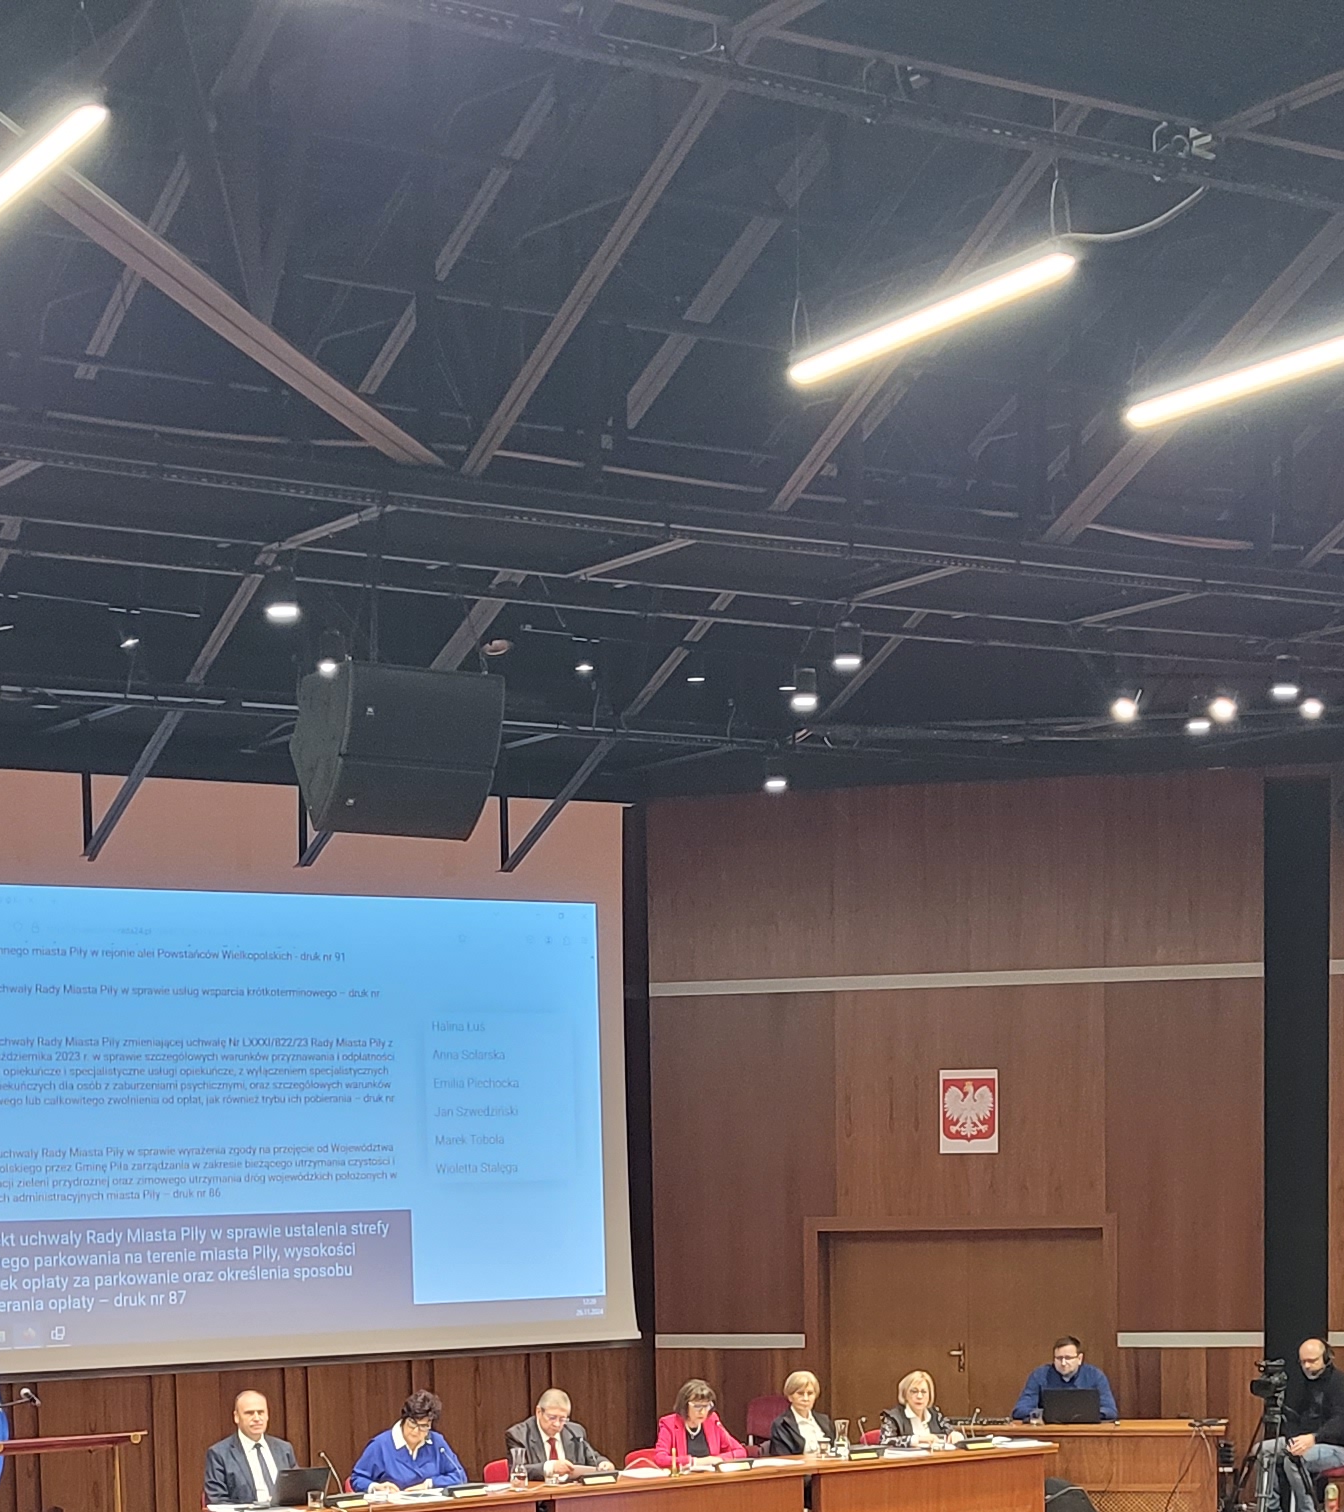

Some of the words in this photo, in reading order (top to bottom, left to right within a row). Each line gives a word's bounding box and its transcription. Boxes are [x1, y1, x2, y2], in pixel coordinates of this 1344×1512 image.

[432, 1020, 464, 1032] Halina
[432, 1049, 459, 1060] Anna
[433, 1078, 464, 1089] Emilia
[467, 1077, 519, 1088] Piechocka
[434, 1106, 453, 1117] Jan
[435, 1134, 466, 1145] Marek
[435, 1163, 477, 1174] Wioletta
[86, 1229, 122, 1248] Rady
[126, 1227, 176, 1243] Miasta
[210, 1229, 222, 1241] w
[226, 1224, 281, 1243] sprawie
[284, 1222, 346, 1239] ustalenia
[350, 1221, 388, 1240] strefy
[33, 1249, 120, 1270] parkowania
[124, 1252, 142, 1264] na
[146, 1247, 195, 1263] terenie
[200, 1245, 248, 1262] miasta
[73, 1275, 89, 1287] za
[94, 1269, 178, 1289] parkowanie
[182, 1271, 213, 1283] oraz
[293, 1262, 352, 1282] sposobu
[113, 1292, 145, 1308] druk
[150, 1294, 164, 1306] nr
[168, 1290, 186, 1305] 87
